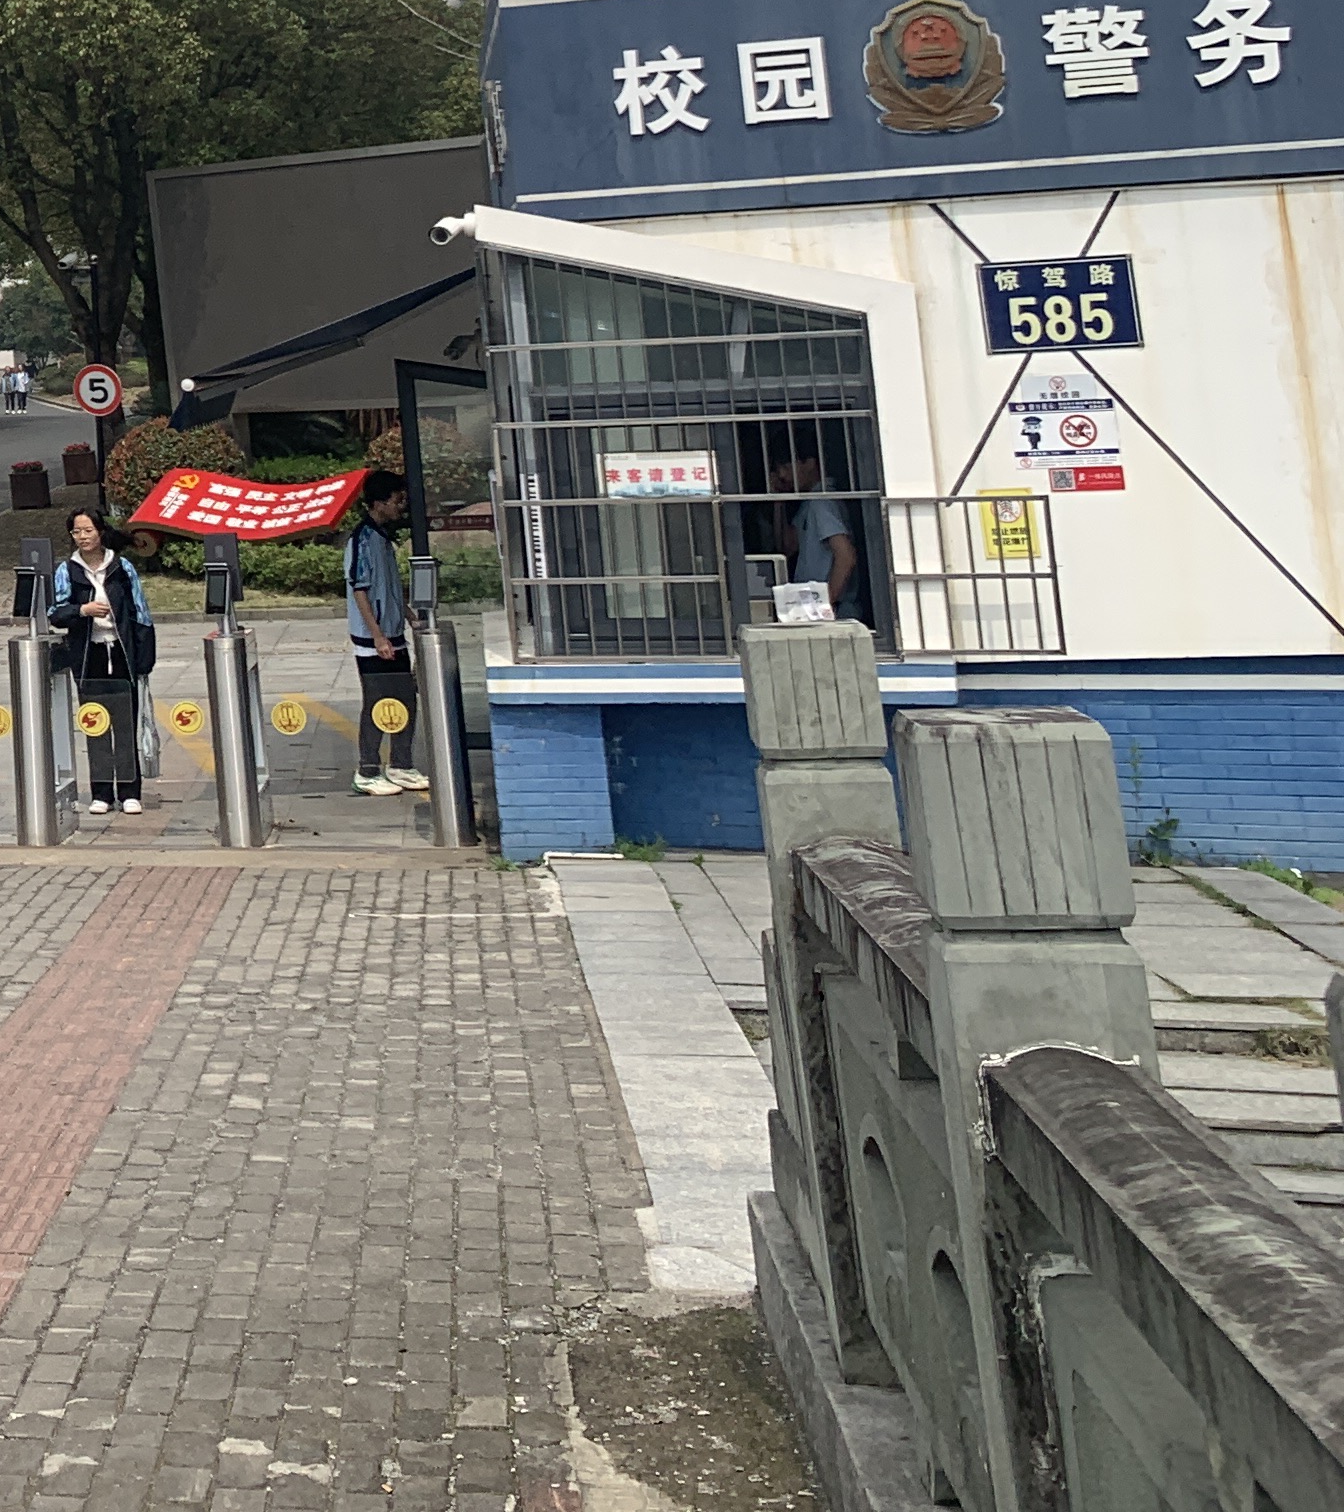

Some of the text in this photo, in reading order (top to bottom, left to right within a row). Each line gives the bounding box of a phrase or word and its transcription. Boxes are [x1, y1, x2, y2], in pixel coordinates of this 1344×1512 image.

[613, 35, 834, 136] 校园
[994, 263, 1115, 292] 惊驾路
[1008, 292, 1114, 345] 585
[89, 378, 109, 404] 5
[605, 467, 708, 484] 来客请登记
